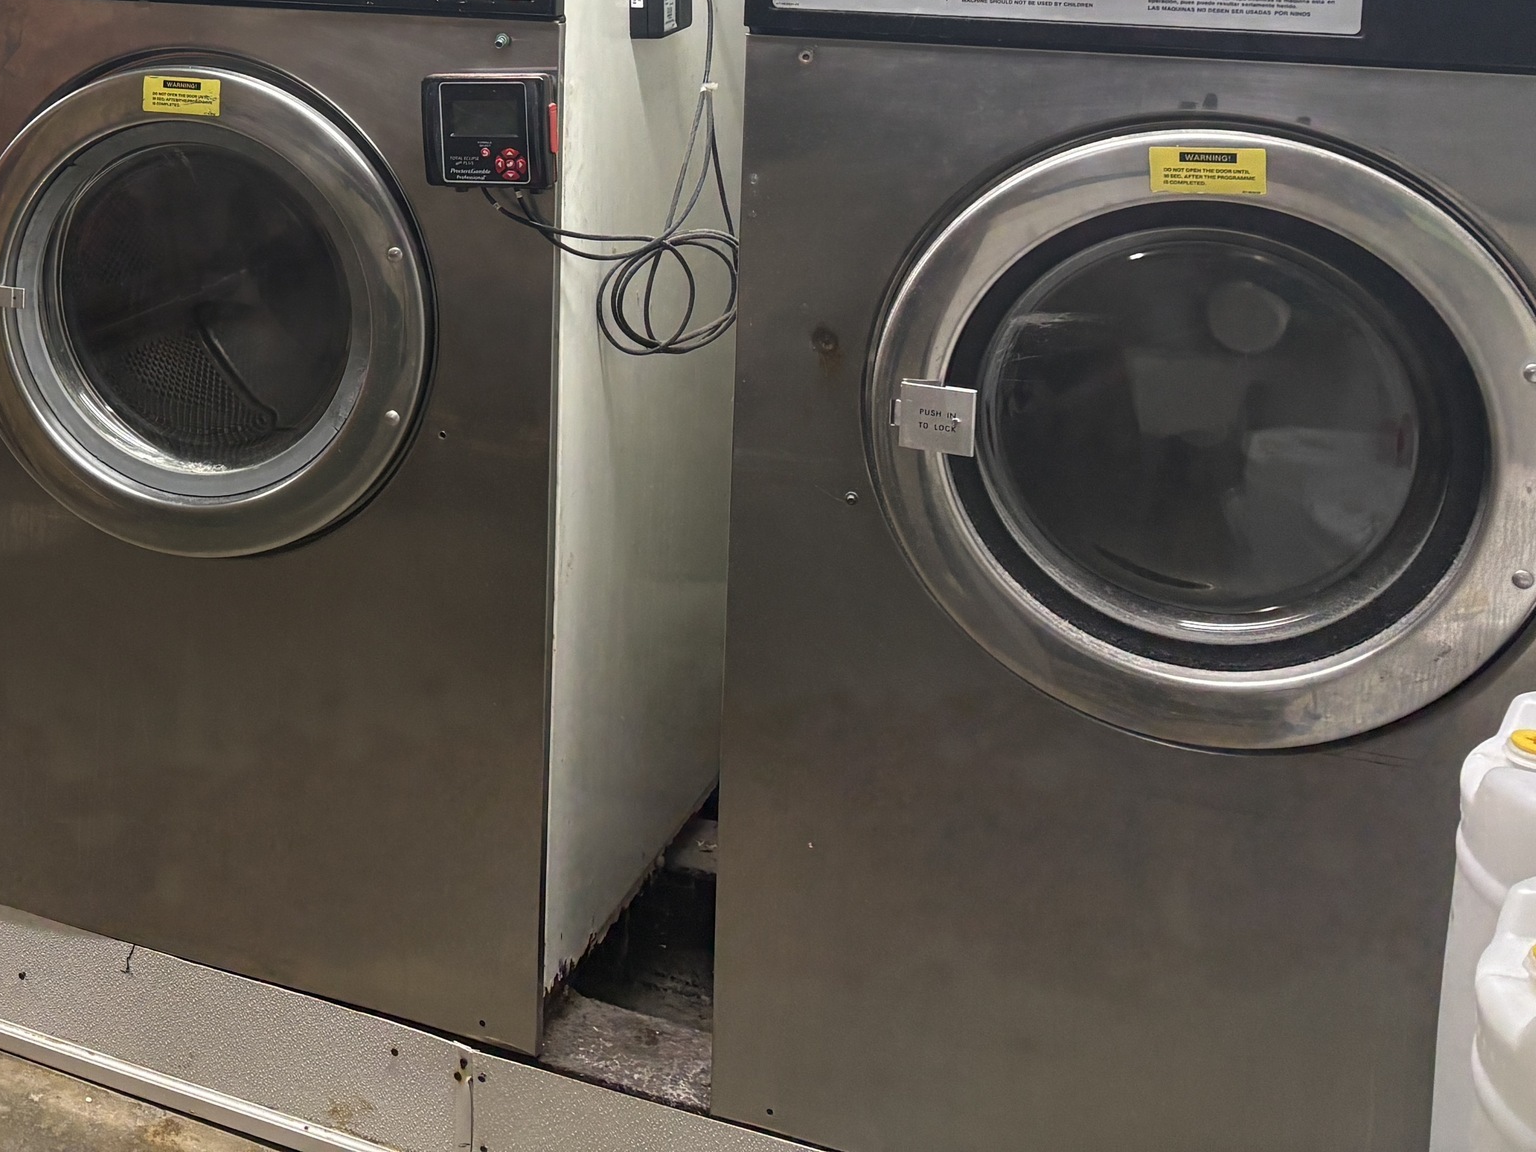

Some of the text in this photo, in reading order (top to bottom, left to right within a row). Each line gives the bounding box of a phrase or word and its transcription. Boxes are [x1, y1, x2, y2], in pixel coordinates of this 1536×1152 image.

[1184, 154, 1231, 162] WARNING!
[919, 408, 942, 417] PUSH
[934, 424, 956, 432] LOCK
